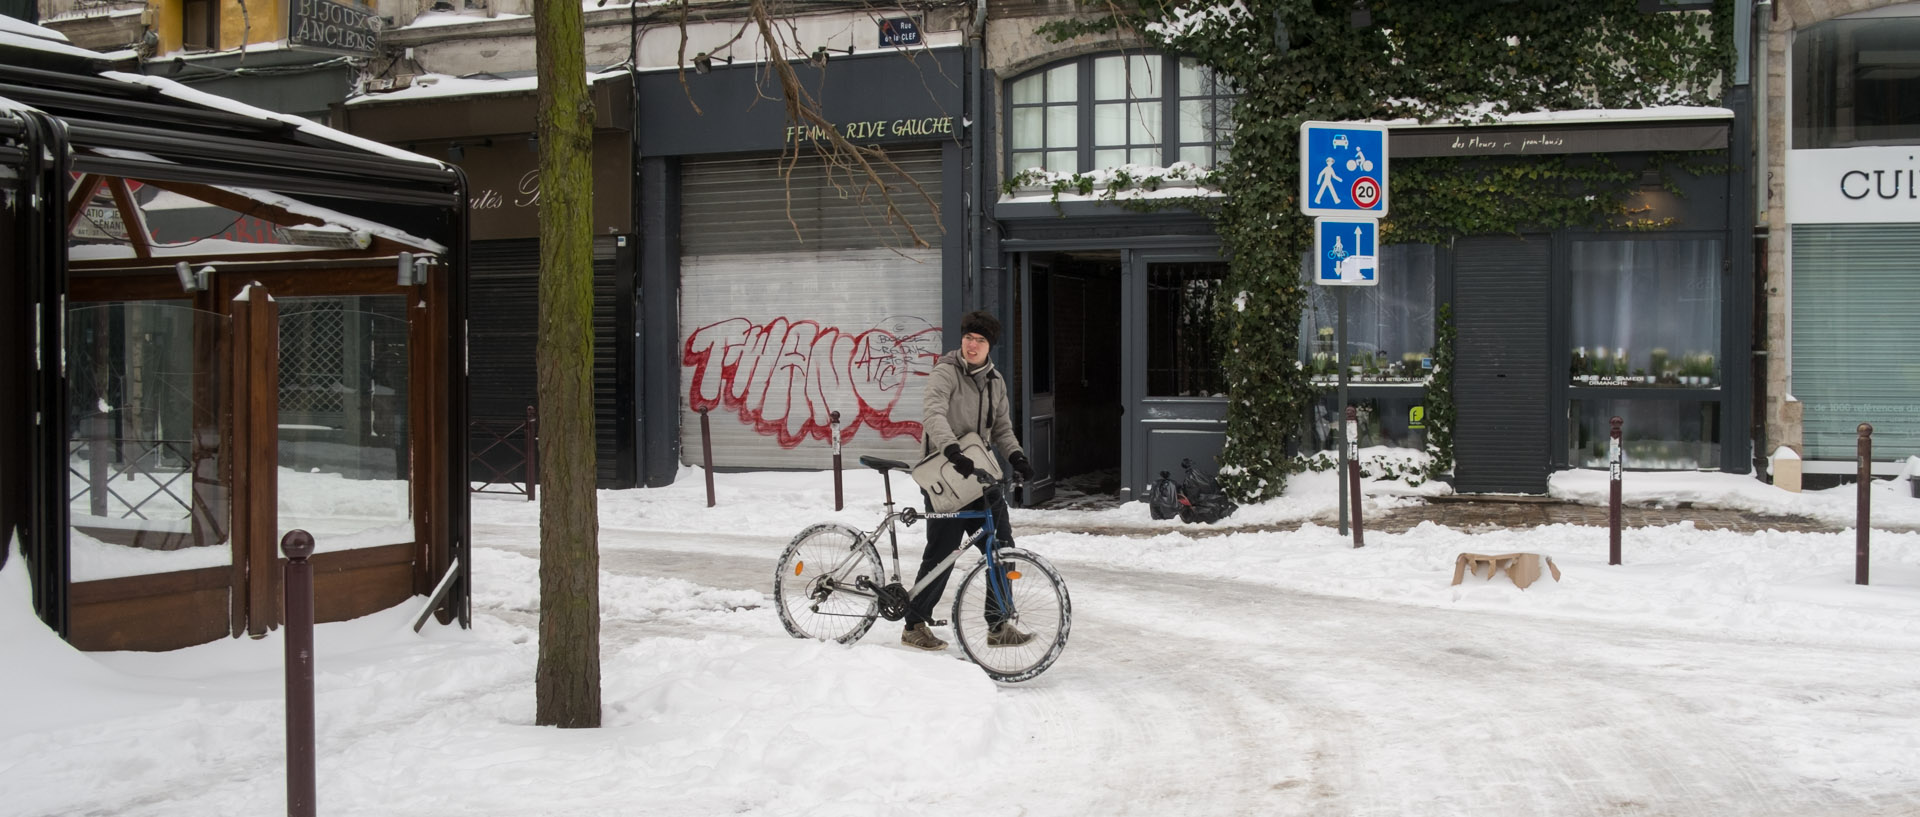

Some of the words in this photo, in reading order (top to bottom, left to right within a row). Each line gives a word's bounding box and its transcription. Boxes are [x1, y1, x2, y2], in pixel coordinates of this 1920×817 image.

[297, 0, 368, 30] BIJOUX
[900, 21, 912, 30] Rue
[901, 32, 917, 41] CLEF
[846, 120, 887, 140] RIVE
[892, 117, 954, 137] GAUCHE
[1451, 136, 1465, 149] des
[1357, 185, 1375, 198] 20
